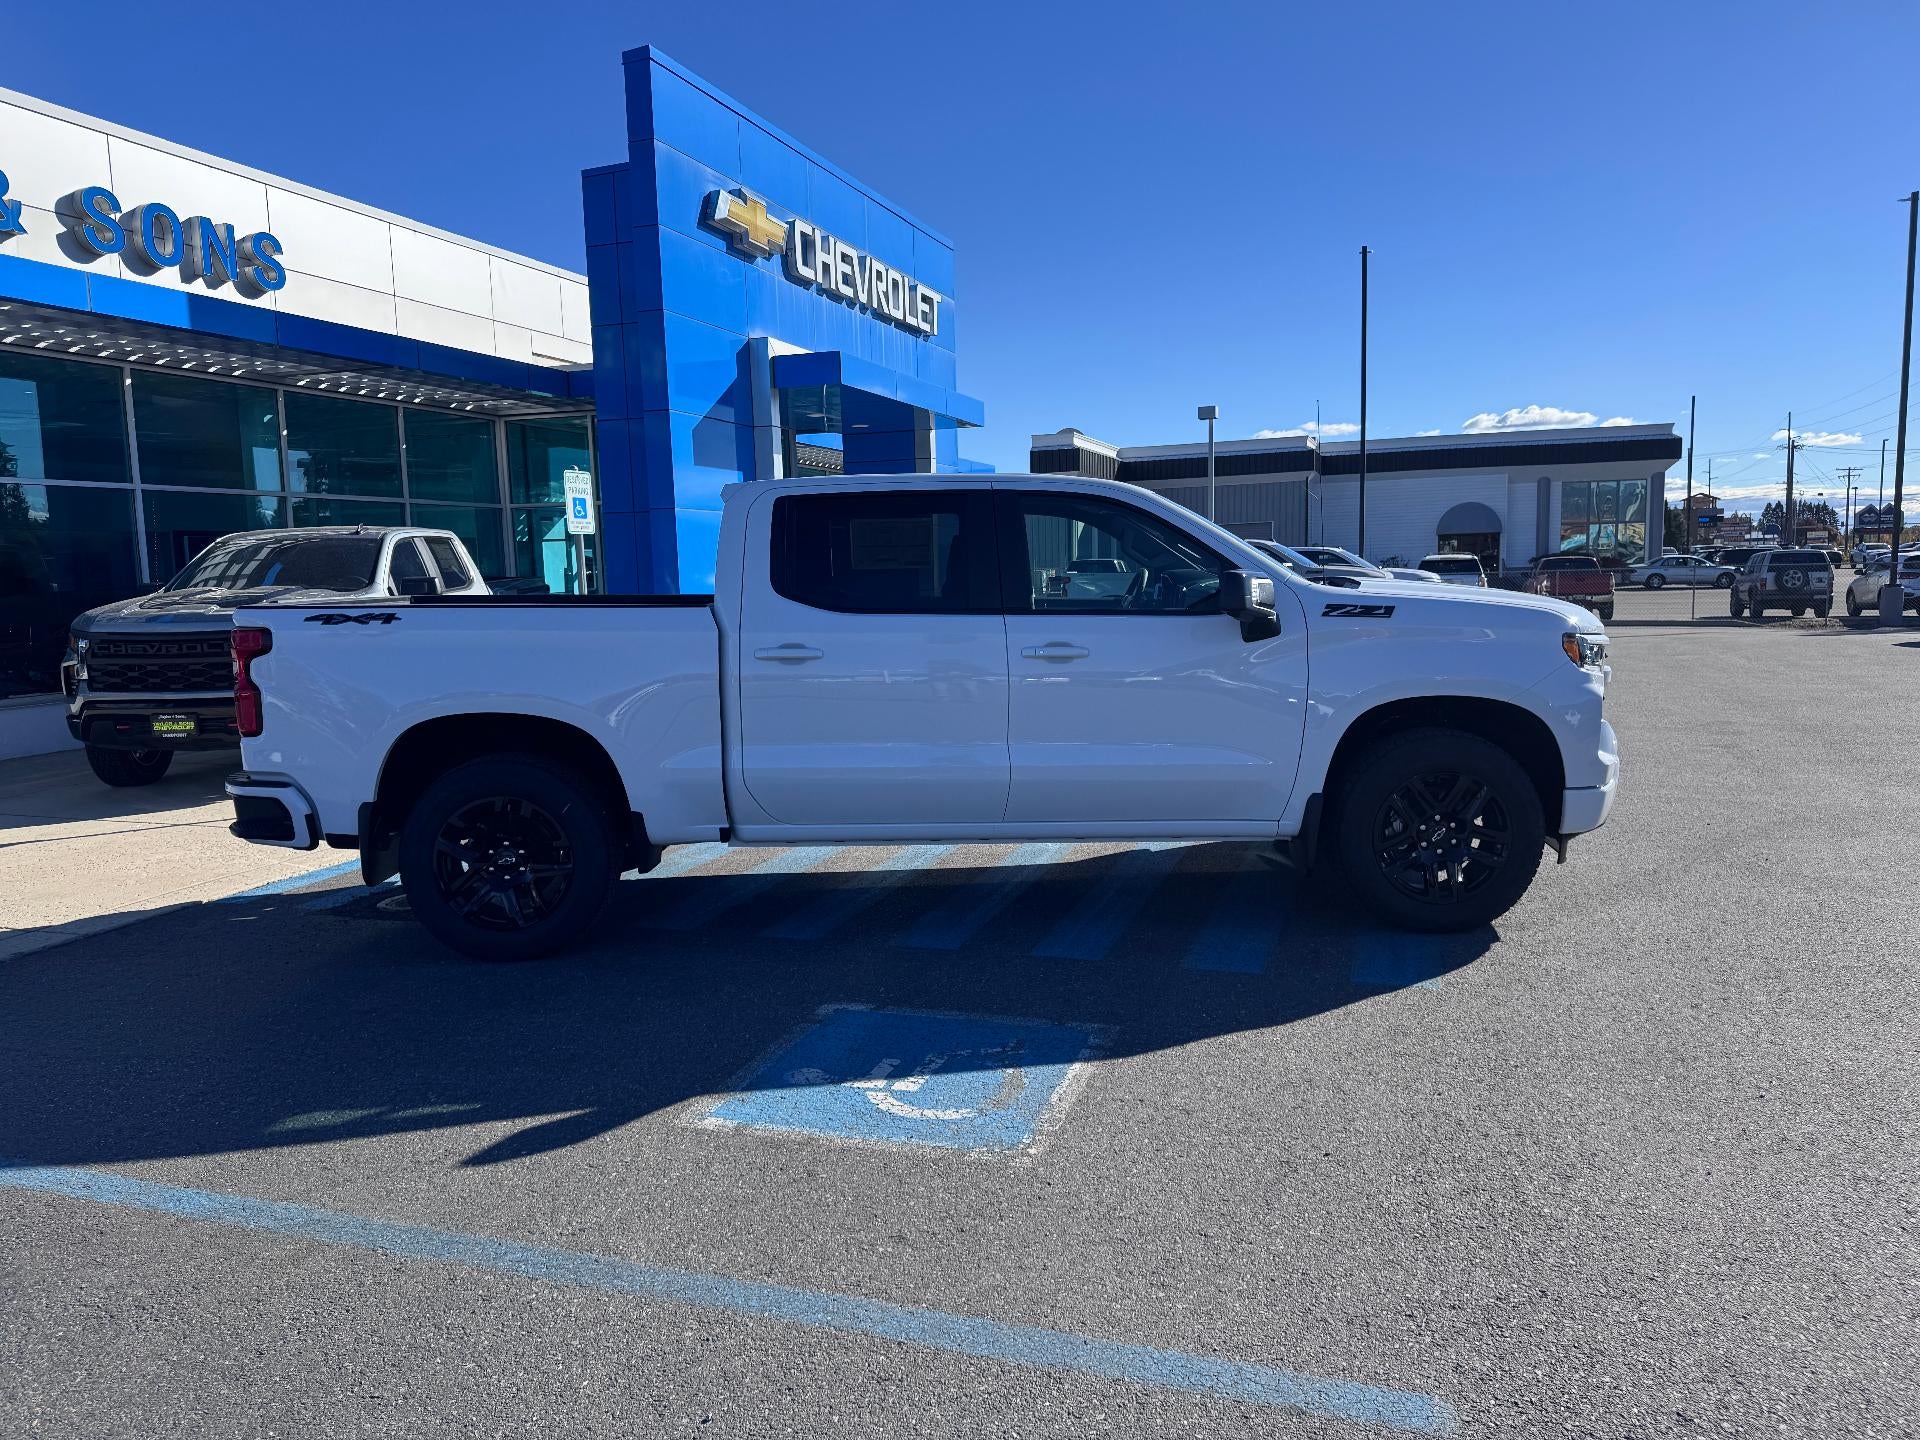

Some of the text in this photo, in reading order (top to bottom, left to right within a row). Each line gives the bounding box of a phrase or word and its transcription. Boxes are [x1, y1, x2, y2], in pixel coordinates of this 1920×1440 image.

[78, 186, 286, 291] SONS
[794, 218, 942, 336] CHEVROLET
[1321, 603, 1395, 618] Z71
